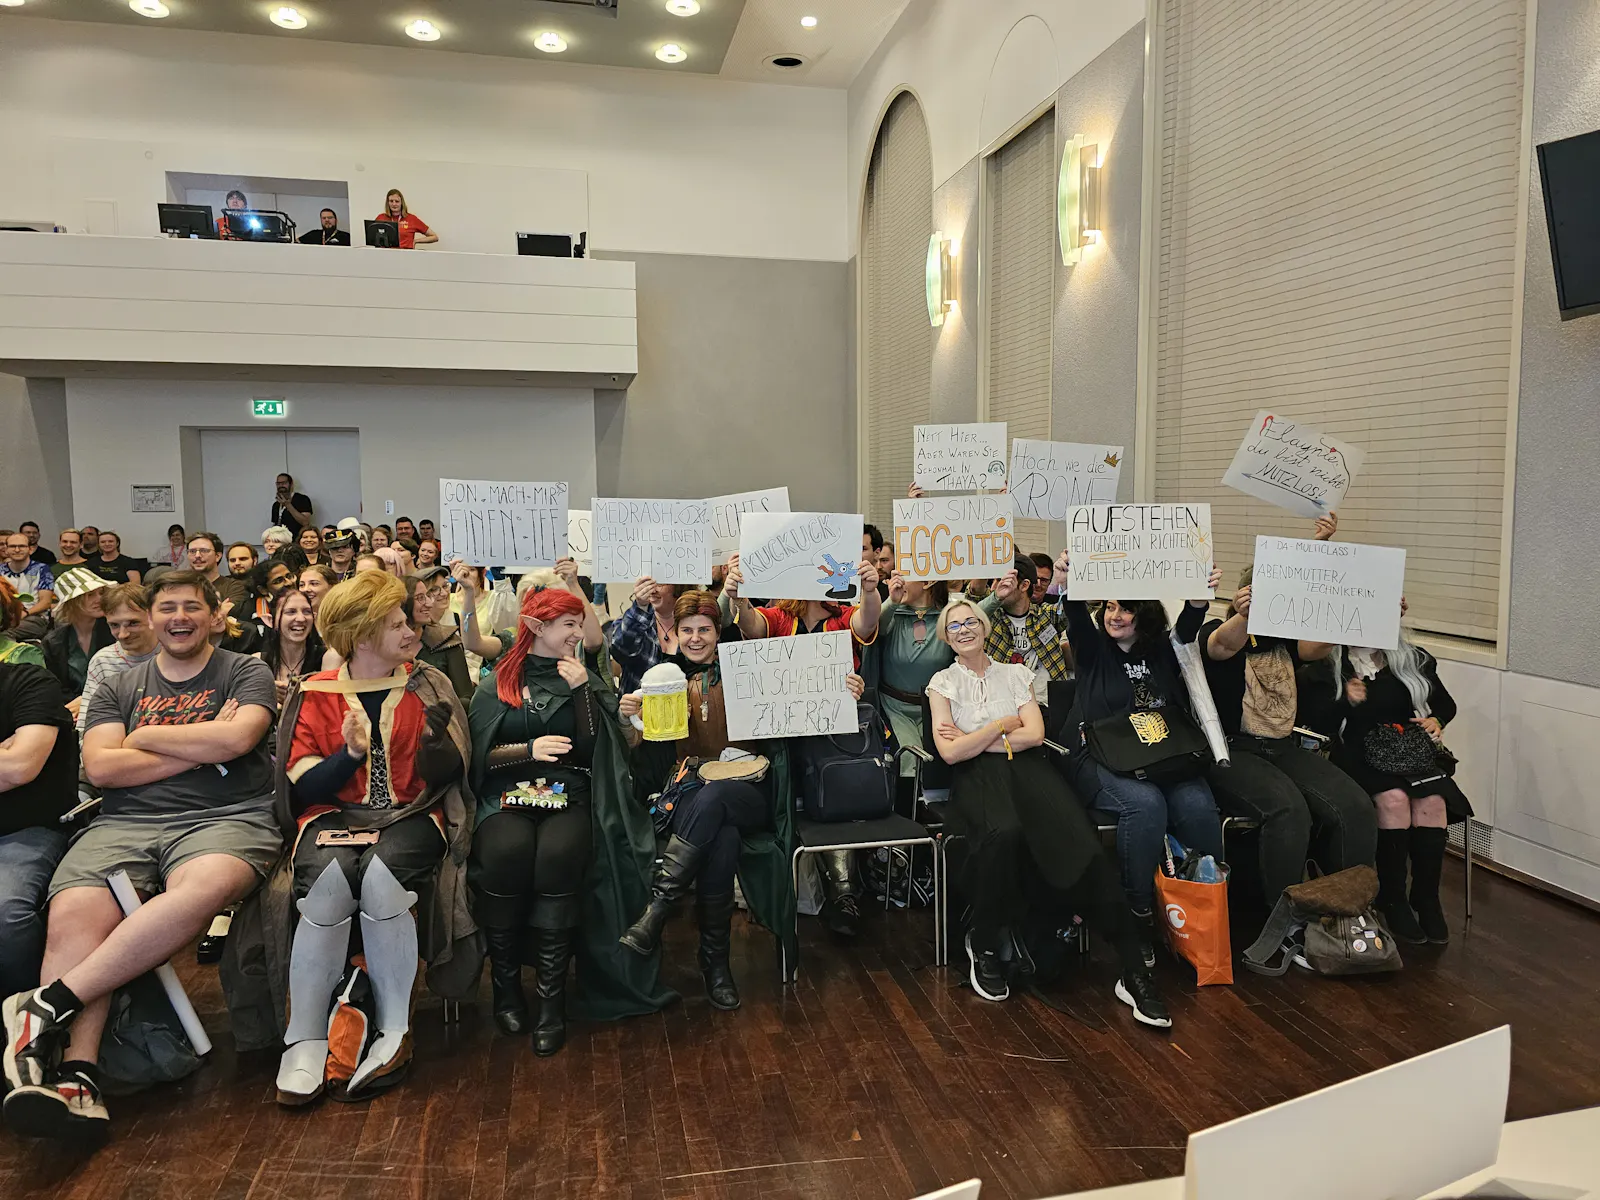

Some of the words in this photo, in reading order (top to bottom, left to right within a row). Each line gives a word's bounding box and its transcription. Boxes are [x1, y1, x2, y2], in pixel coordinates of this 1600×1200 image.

[1014, 442, 1058, 471] Hoch
[1086, 453, 1107, 474] die
[1246, 440, 1268, 456] du
[1273, 446, 1311, 468] bist
[1309, 464, 1346, 490] nicht
[444, 481, 477, 503] GON
[489, 485, 526, 504] MACH
[534, 486, 558, 506] MIR
[1008, 471, 1115, 520] KRONE
[1255, 461, 1328, 500] NUTZLOS!
[898, 500, 934, 521] WIR
[944, 497, 999, 521] SIND
[1072, 505, 1199, 534] AUFSTEHEN
[450, 508, 518, 561] EINEN
[596, 526, 618, 543] ICH
[625, 528, 657, 543] WILL
[661, 528, 704, 544] EINEN
[742, 514, 836, 578] KUCKUCK
[1070, 534, 1141, 553] HEILIGENSCHEIN
[1150, 532, 1194, 550] RICHTEN
[597, 544, 653, 578] FISCH
[662, 546, 698, 559] VON
[1072, 558, 1208, 582] WEITERKÄMPFEN
[1305, 581, 1376, 599] TECHNIKERIN
[1267, 593, 1363, 638] CARINA
[726, 638, 797, 668] PEREN
[814, 632, 845, 659] IST
[734, 671, 764, 699] EIN
[770, 660, 853, 696] SCHLECHTER
[751, 698, 842, 736] ZWERG!
